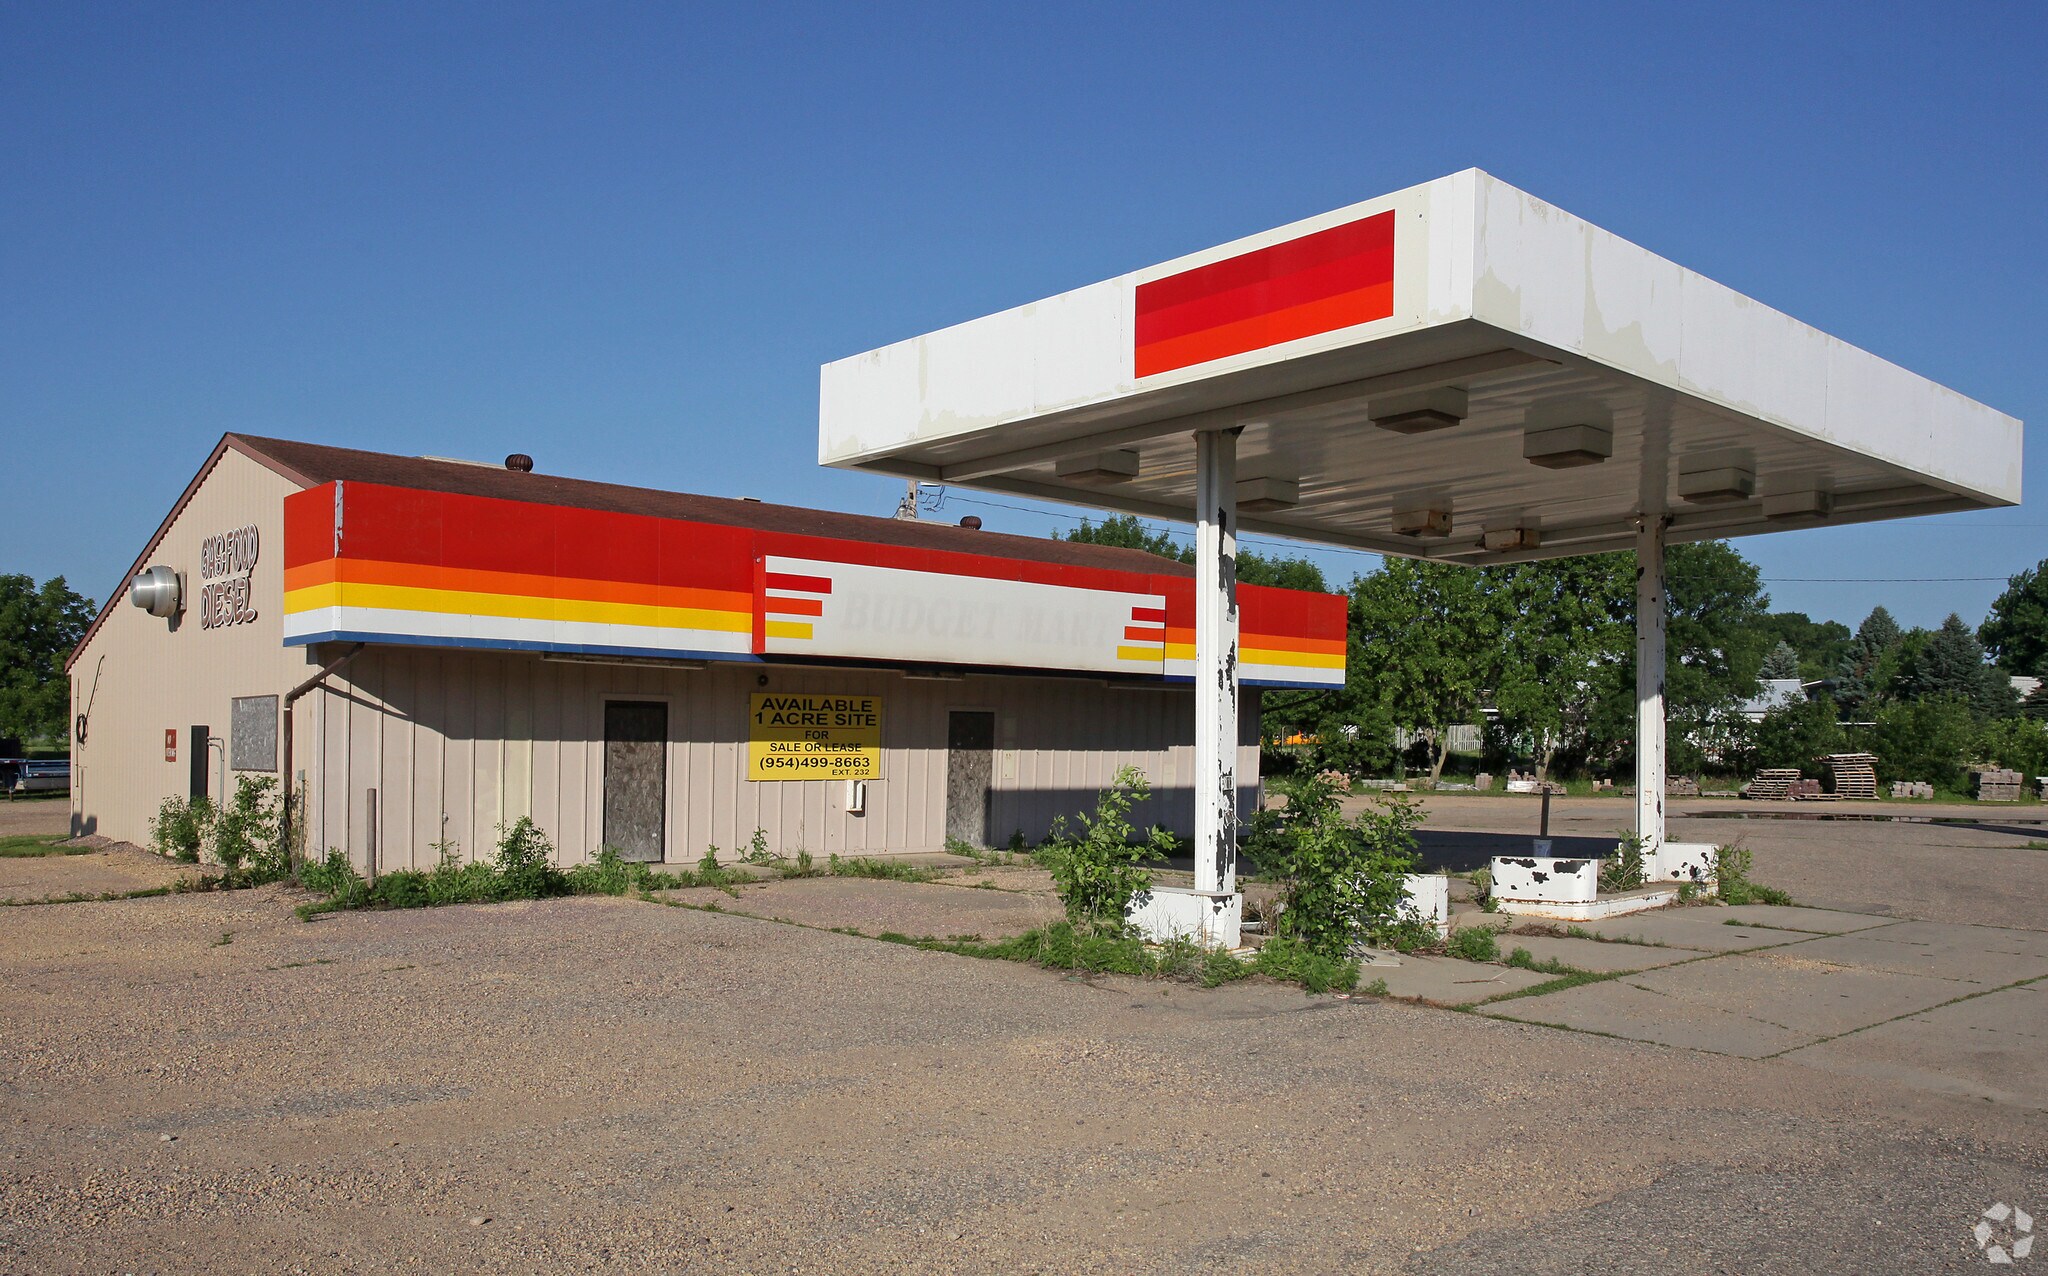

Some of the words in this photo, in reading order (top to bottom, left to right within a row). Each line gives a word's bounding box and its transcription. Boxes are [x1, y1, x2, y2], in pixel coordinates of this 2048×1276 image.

[201, 577, 258, 630] DIESEL
[840, 589, 1004, 640] BUDGET
[1016, 604, 1113, 648] MART
[760, 697, 873, 712] AVAILABLE
[755, 711, 763, 725] 1
[770, 712, 828, 726] ACRE
[834, 713, 877, 726] SITE
[805, 730, 829, 740] FOR
[769, 742, 801, 752] SALE
[804, 742, 822, 752] OR
[825, 743, 862, 752] LEASE
[759, 757, 870, 771] (954)499-8663
